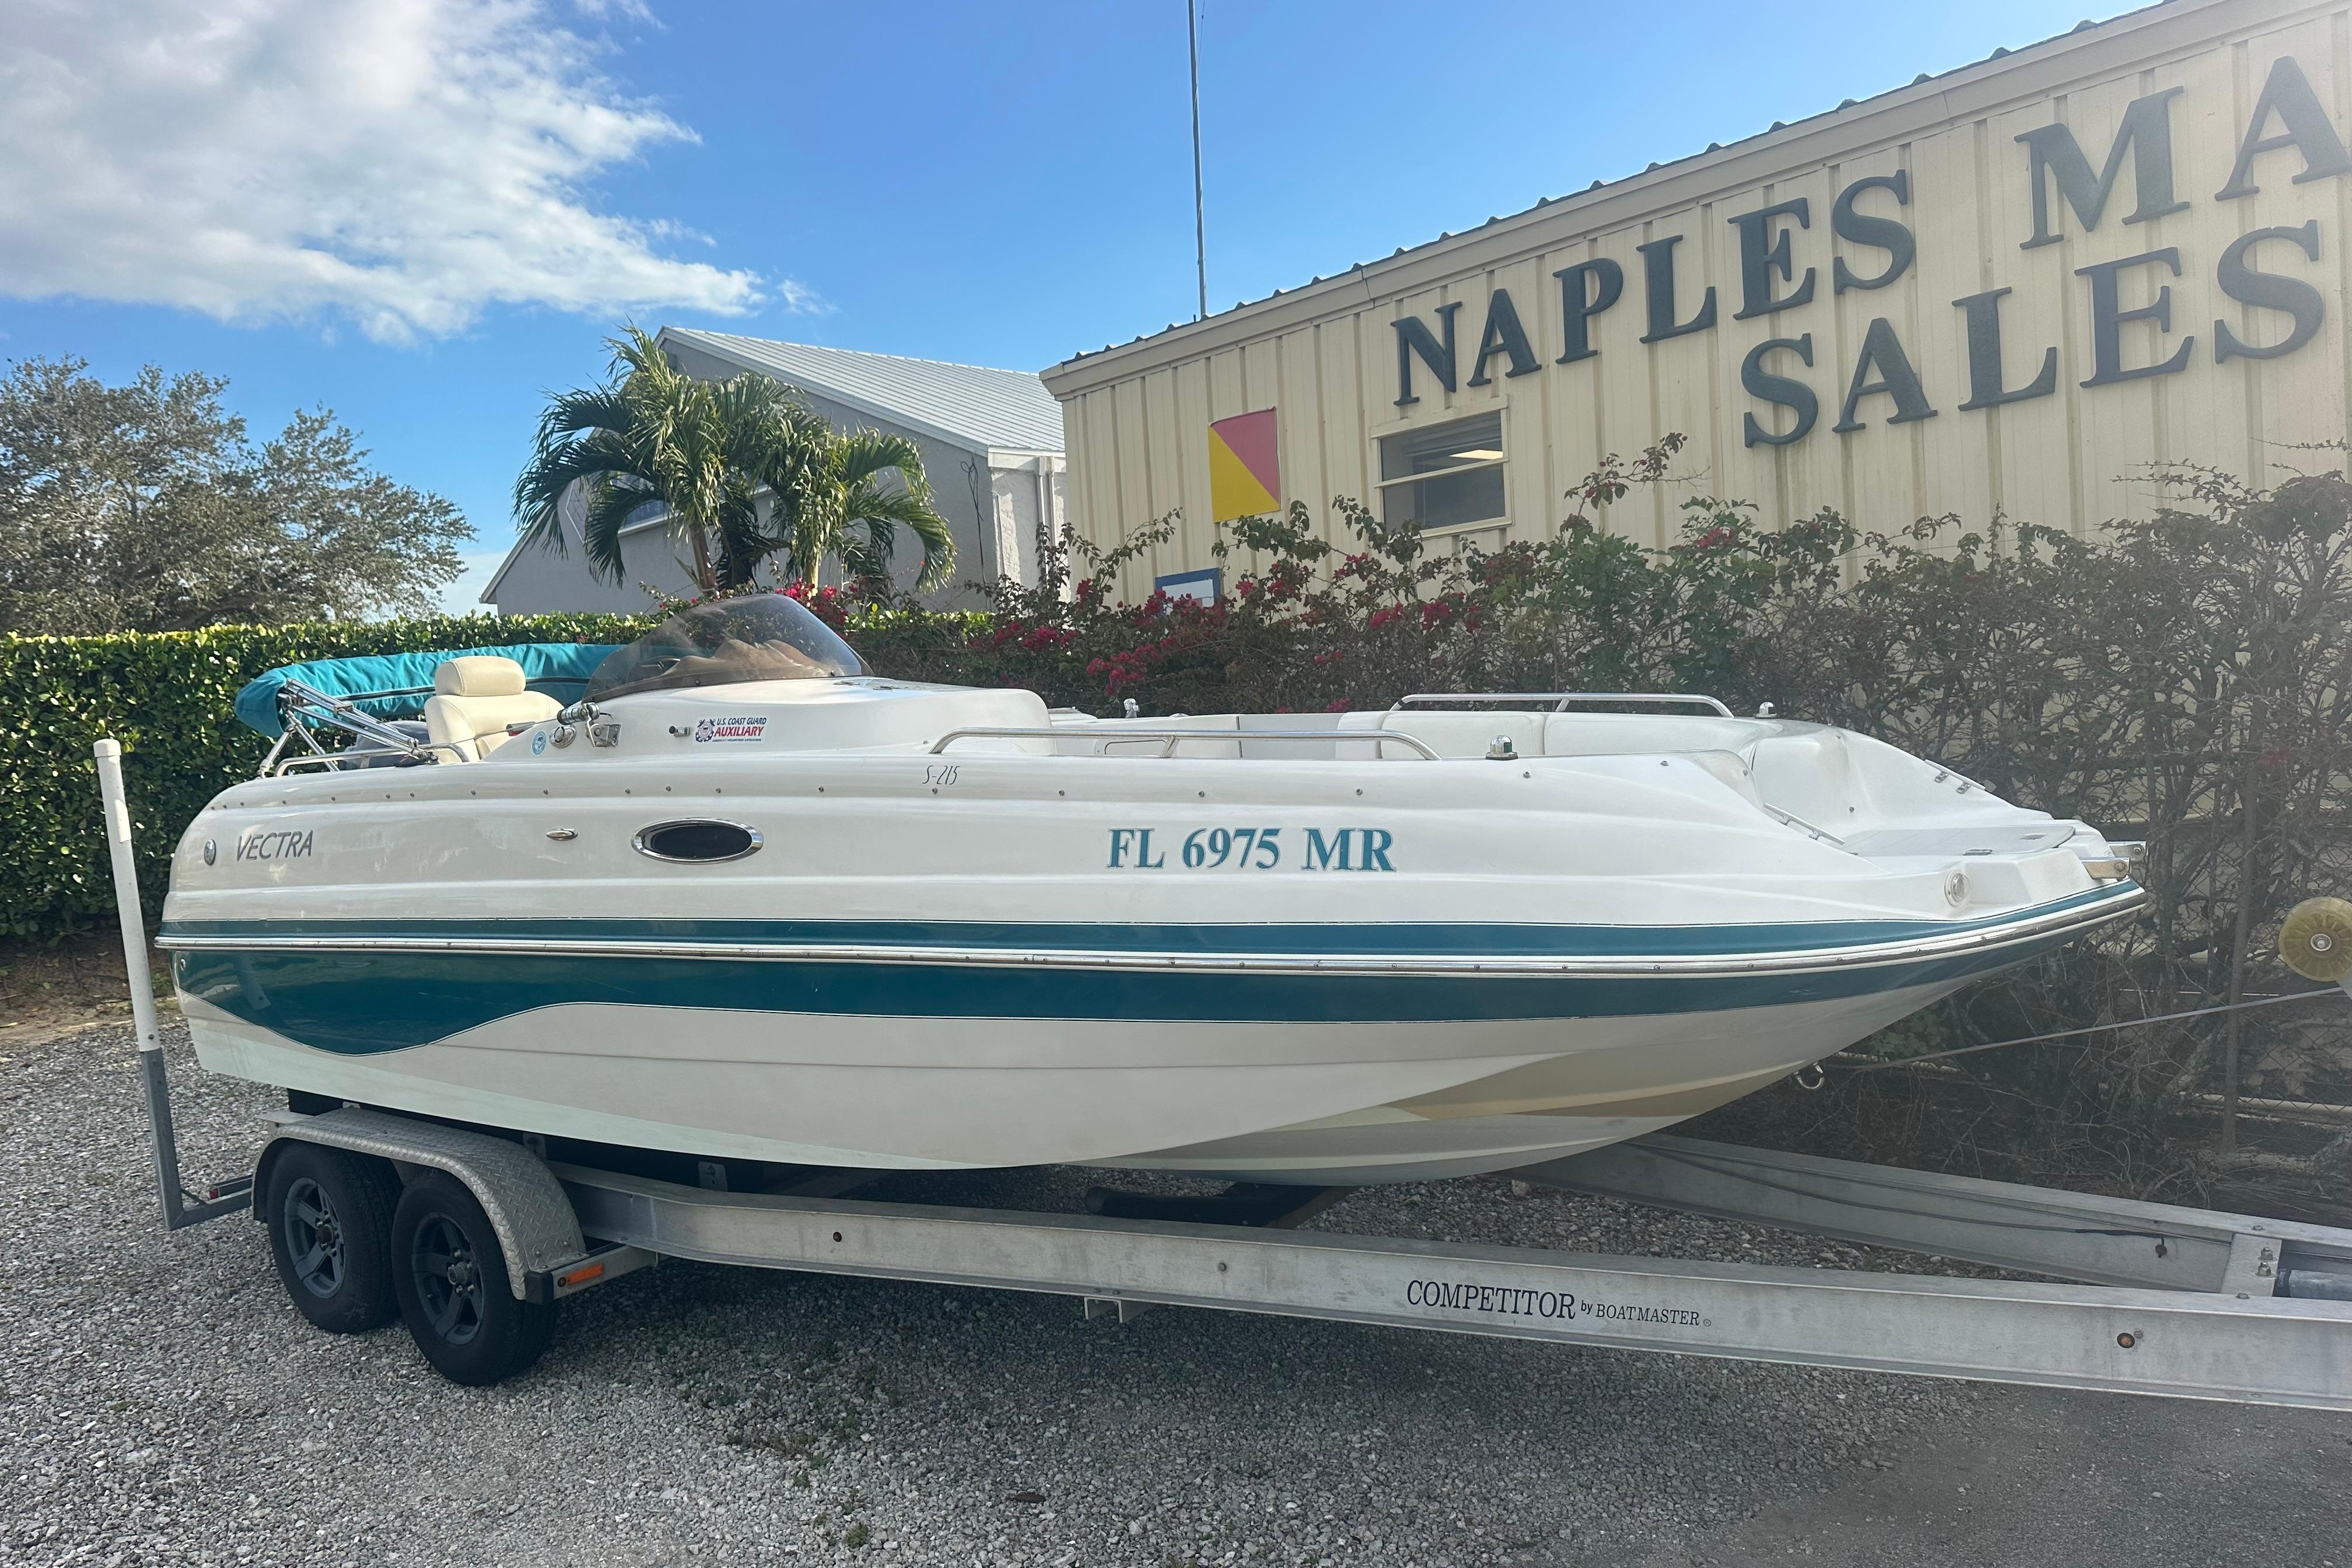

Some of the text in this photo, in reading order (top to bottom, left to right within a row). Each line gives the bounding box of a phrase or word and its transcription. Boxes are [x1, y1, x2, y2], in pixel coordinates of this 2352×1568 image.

[1390, 55, 2352, 406] NAPLES MA
[1743, 219, 2324, 448] SALES
[714, 726, 765, 737] AUXILIARY
[922, 765, 961, 785] S-215
[237, 830, 313, 862] VECTRA
[1108, 827, 1397, 872] FL 6975 MR
[1406, 1279, 1700, 1326] COMPETITOR by BOATMASTER
